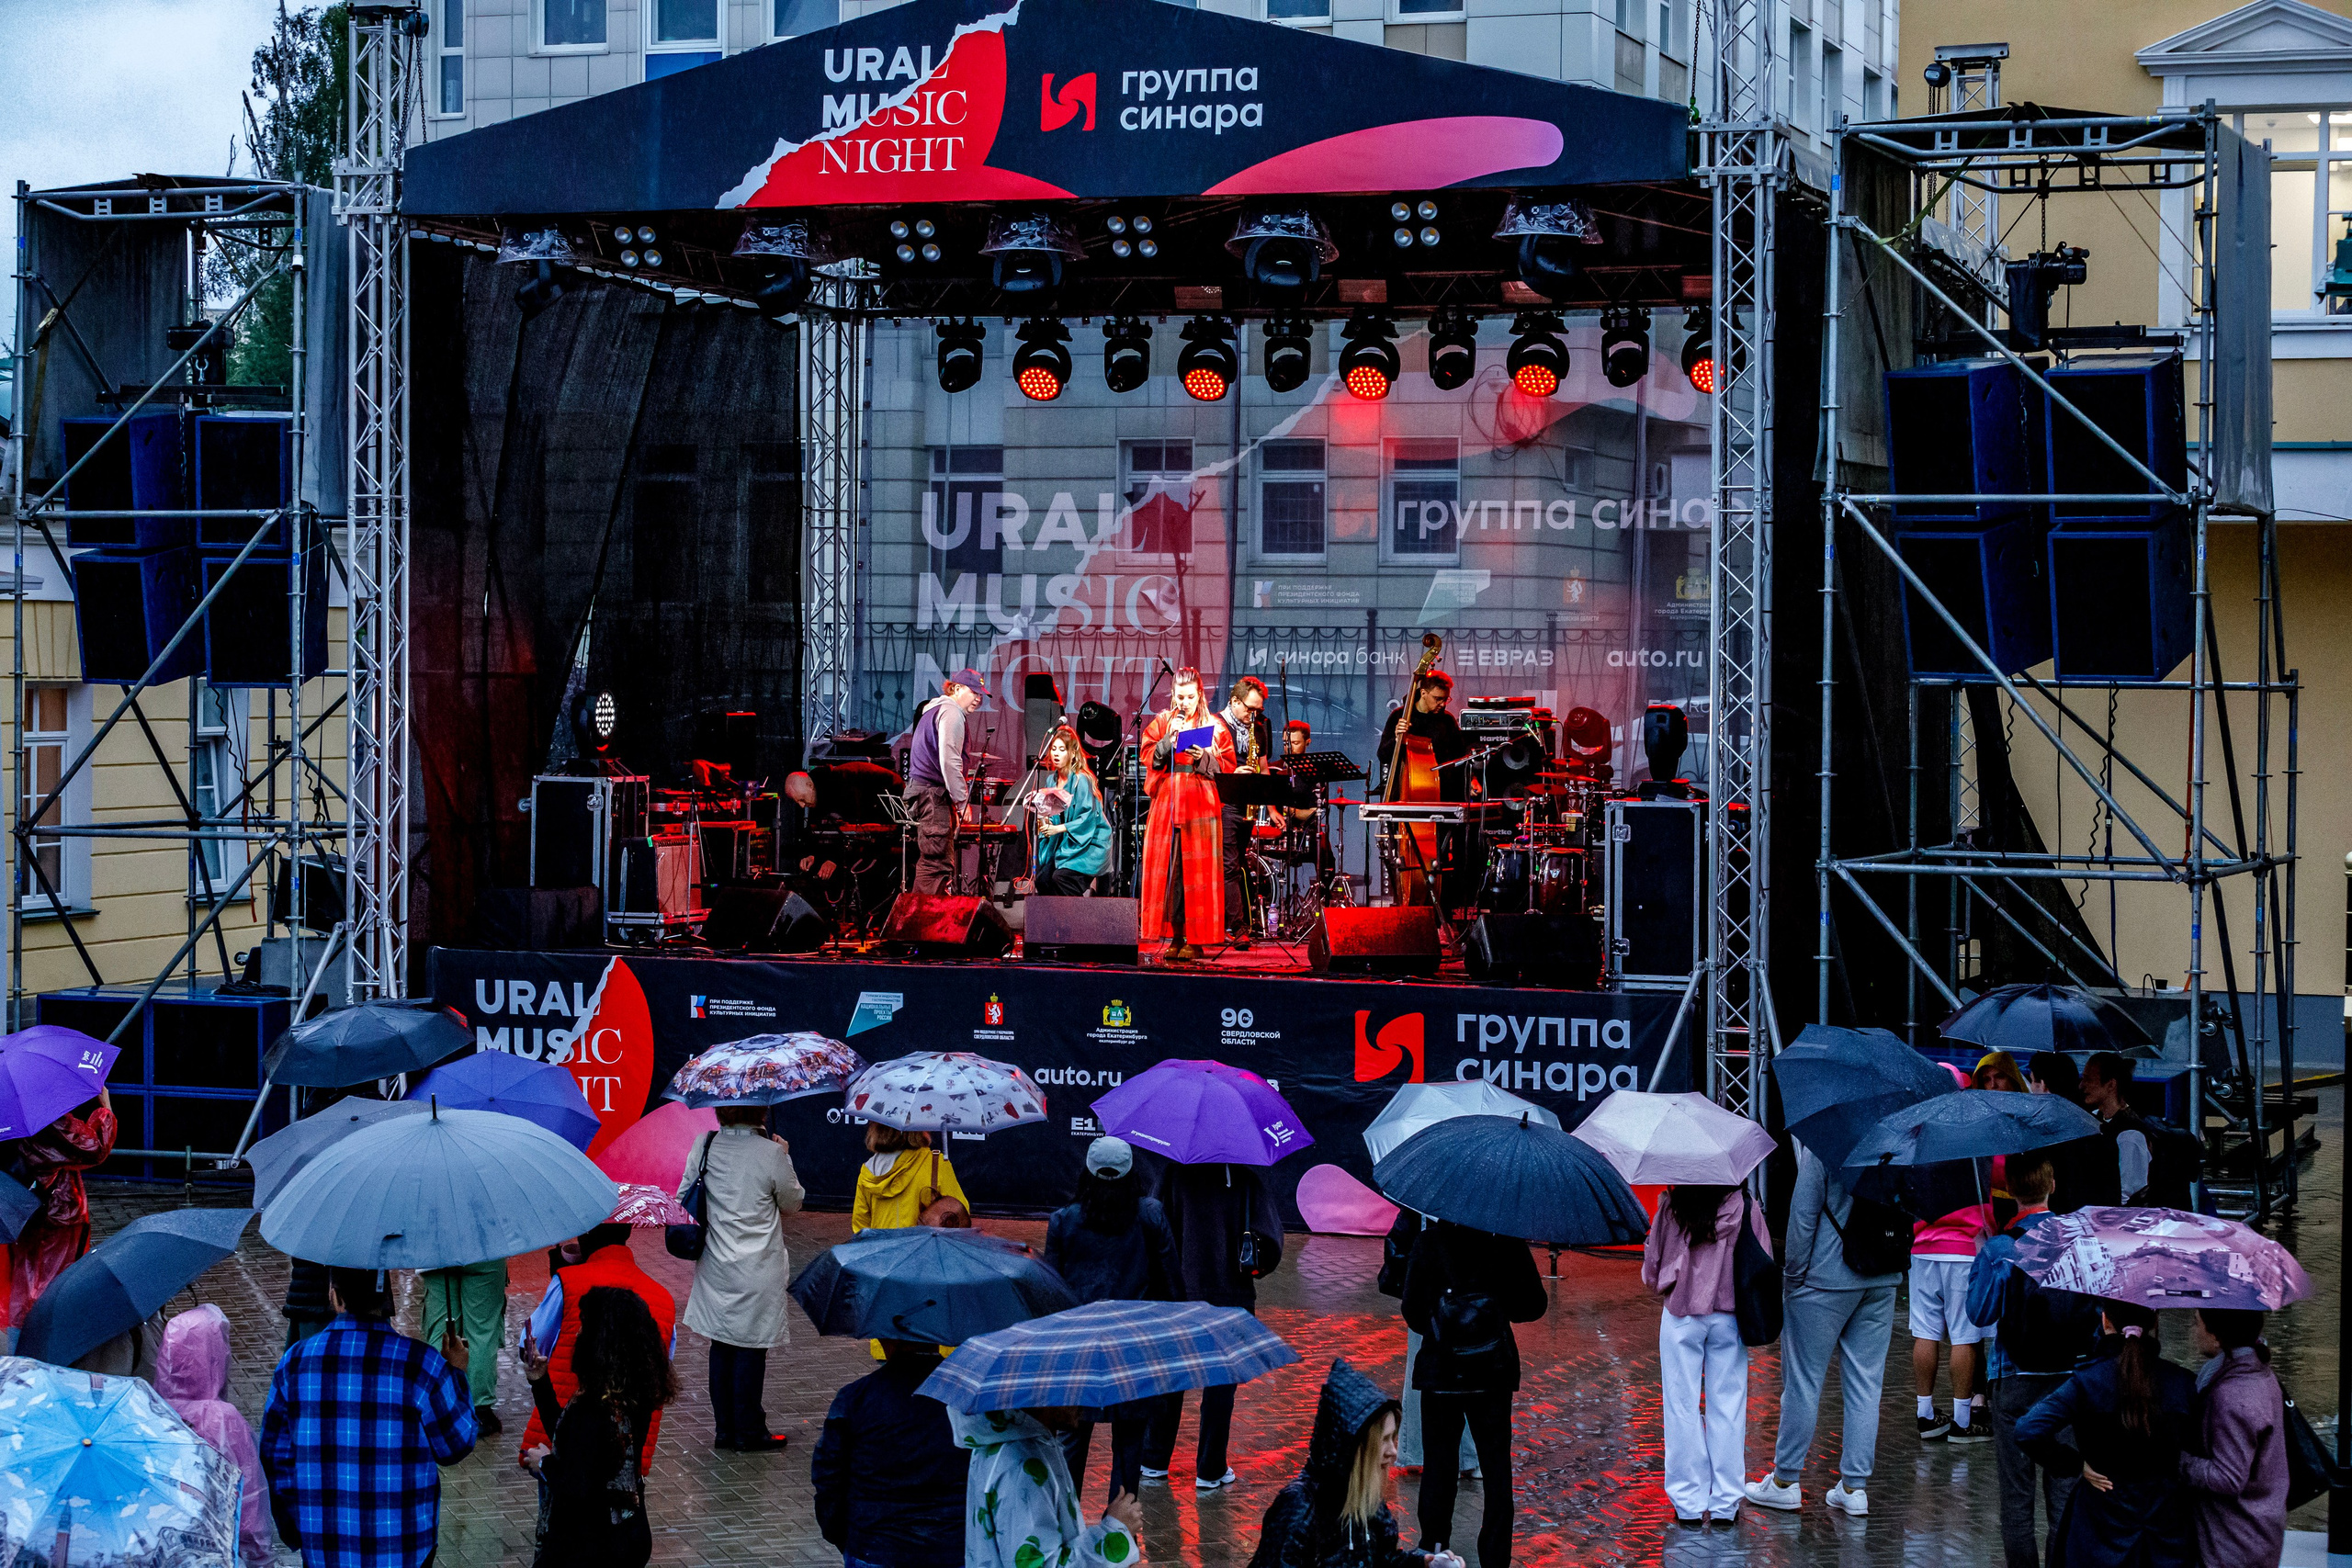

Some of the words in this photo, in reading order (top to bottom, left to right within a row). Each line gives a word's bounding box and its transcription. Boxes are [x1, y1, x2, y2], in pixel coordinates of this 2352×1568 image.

[824, 45, 949, 83] URAL
[1122, 67, 1259, 101] группа
[822, 90, 967, 128] MUSIC
[1120, 103, 1263, 135] синара
[819, 137, 965, 174] NIGHT
[922, 492, 1148, 551] URAL
[1396, 499, 1576, 539] группа
[917, 572, 1181, 635] MUSIC
[1274, 649, 1349, 668] синара
[1355, 647, 1406, 665] банк
[1478, 649, 1555, 666] ЕВРАЗ
[1608, 647, 1702, 667] auto.ru
[476, 979, 601, 1017] URAL
[1221, 1008, 1253, 1028] 90
[1221, 1030, 1281, 1039] СВЕРДЛОВСКОЙ
[1457, 1013, 1631, 1054] группа
[476, 1026, 623, 1066] MUSIC
[1035, 1066, 1122, 1088] auto.ru
[1456, 1058, 1638, 1101] синара
